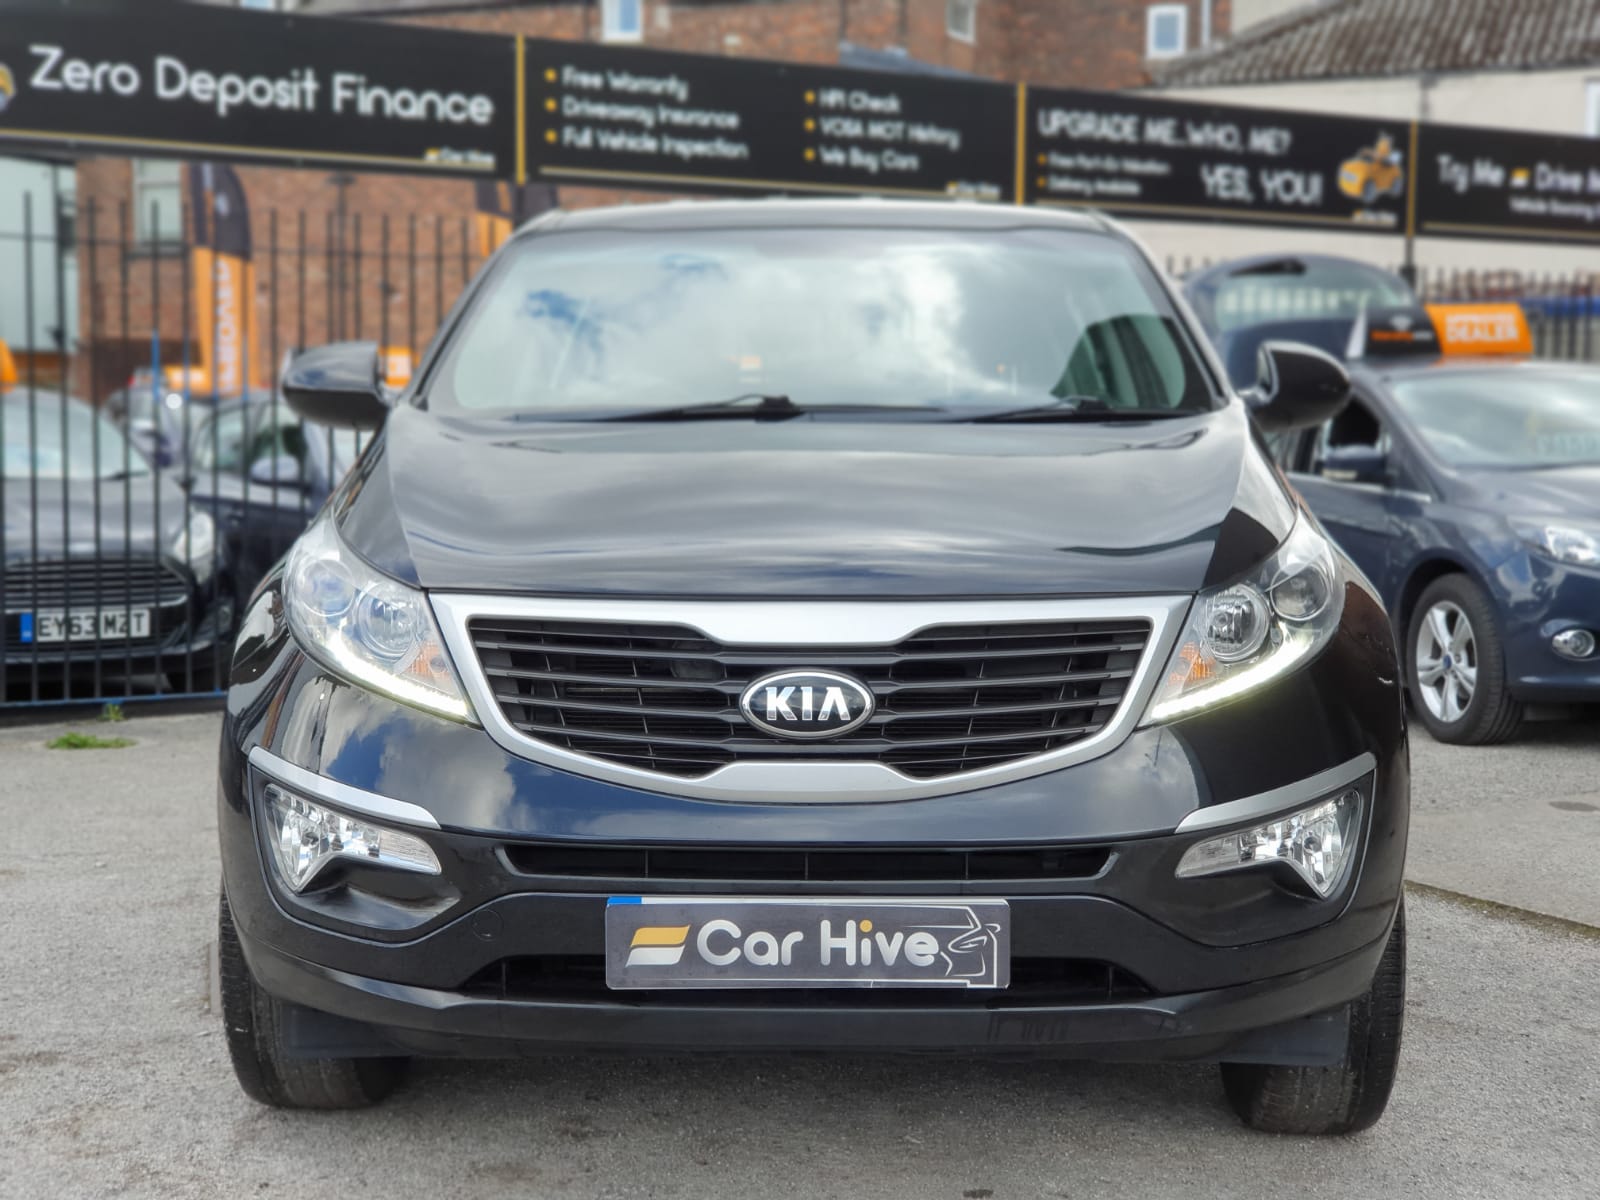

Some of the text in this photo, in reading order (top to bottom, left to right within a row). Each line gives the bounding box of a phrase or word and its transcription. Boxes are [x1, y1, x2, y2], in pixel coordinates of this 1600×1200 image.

[29, 44, 494, 125] Zero Deposit Finance
[563, 65, 689, 102] Free Warranty
[849, 90, 901, 113] Check
[562, 96, 739, 128] Driveaway Insurance
[562, 126, 749, 162] Full Vehicle Inspection
[1038, 108, 1139, 143] UPGRADE
[1249, 128, 1292, 155] ME?
[818, 146, 919, 173] We Buy Cars
[1437, 154, 1469, 194] Try
[1201, 164, 1323, 206] YES, YOU!
[765, 686, 851, 721] KIA
[697, 919, 940, 967] Car Hive
